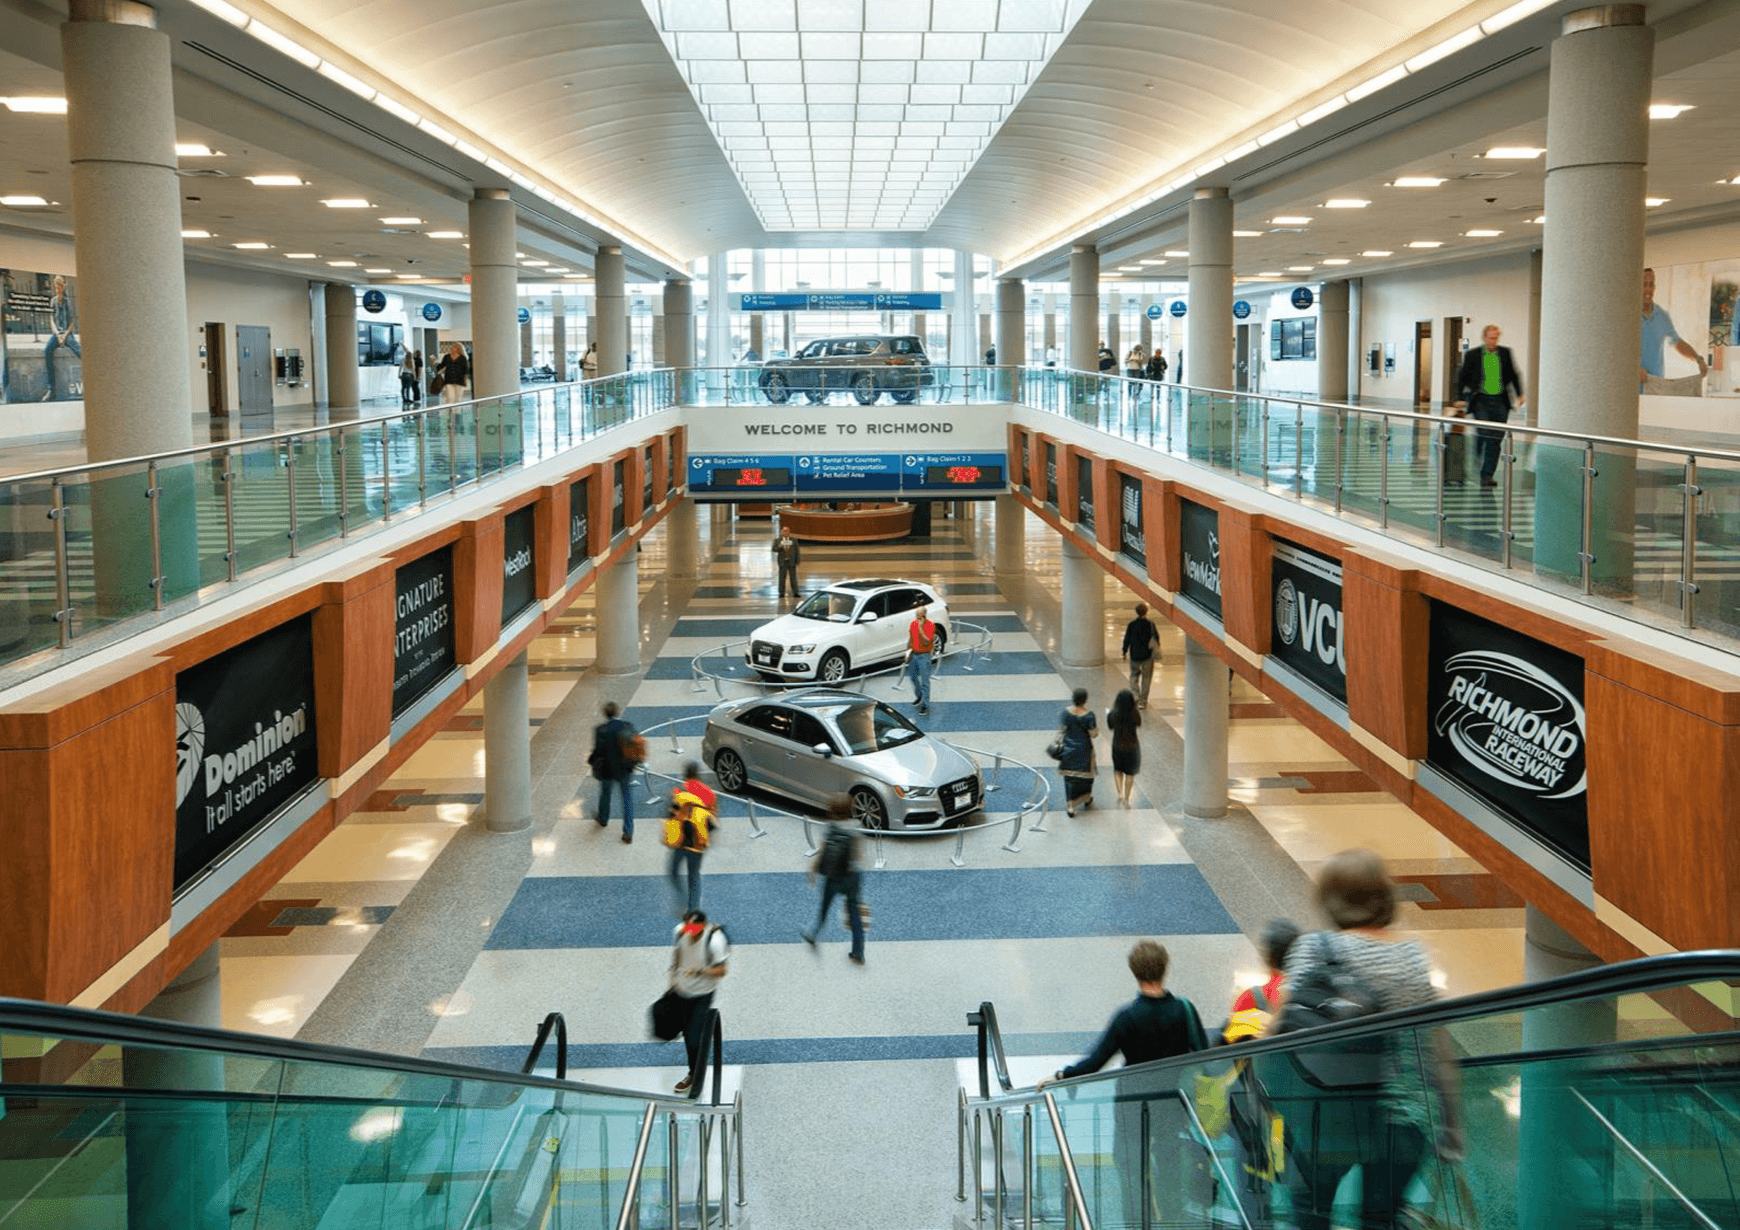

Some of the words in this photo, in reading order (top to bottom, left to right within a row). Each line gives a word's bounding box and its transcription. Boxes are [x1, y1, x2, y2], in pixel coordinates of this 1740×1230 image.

[745, 424, 827, 435] WELCOME
[836, 424, 858, 435] TO
[867, 423, 954, 434] RICHMOND
[1183, 552, 1221, 596] NewMark
[395, 604, 448, 658] NTERPRISES
[1448, 675, 1578, 759] RICHMOND
[204, 708, 306, 798] Dominion
[1484, 735, 1565, 788] RACEWAY
[1492, 724, 1566, 773] INTERNATIONAL
[205, 805, 215, 834] It
[217, 790, 233, 825] all
[234, 774, 266, 812] starts
